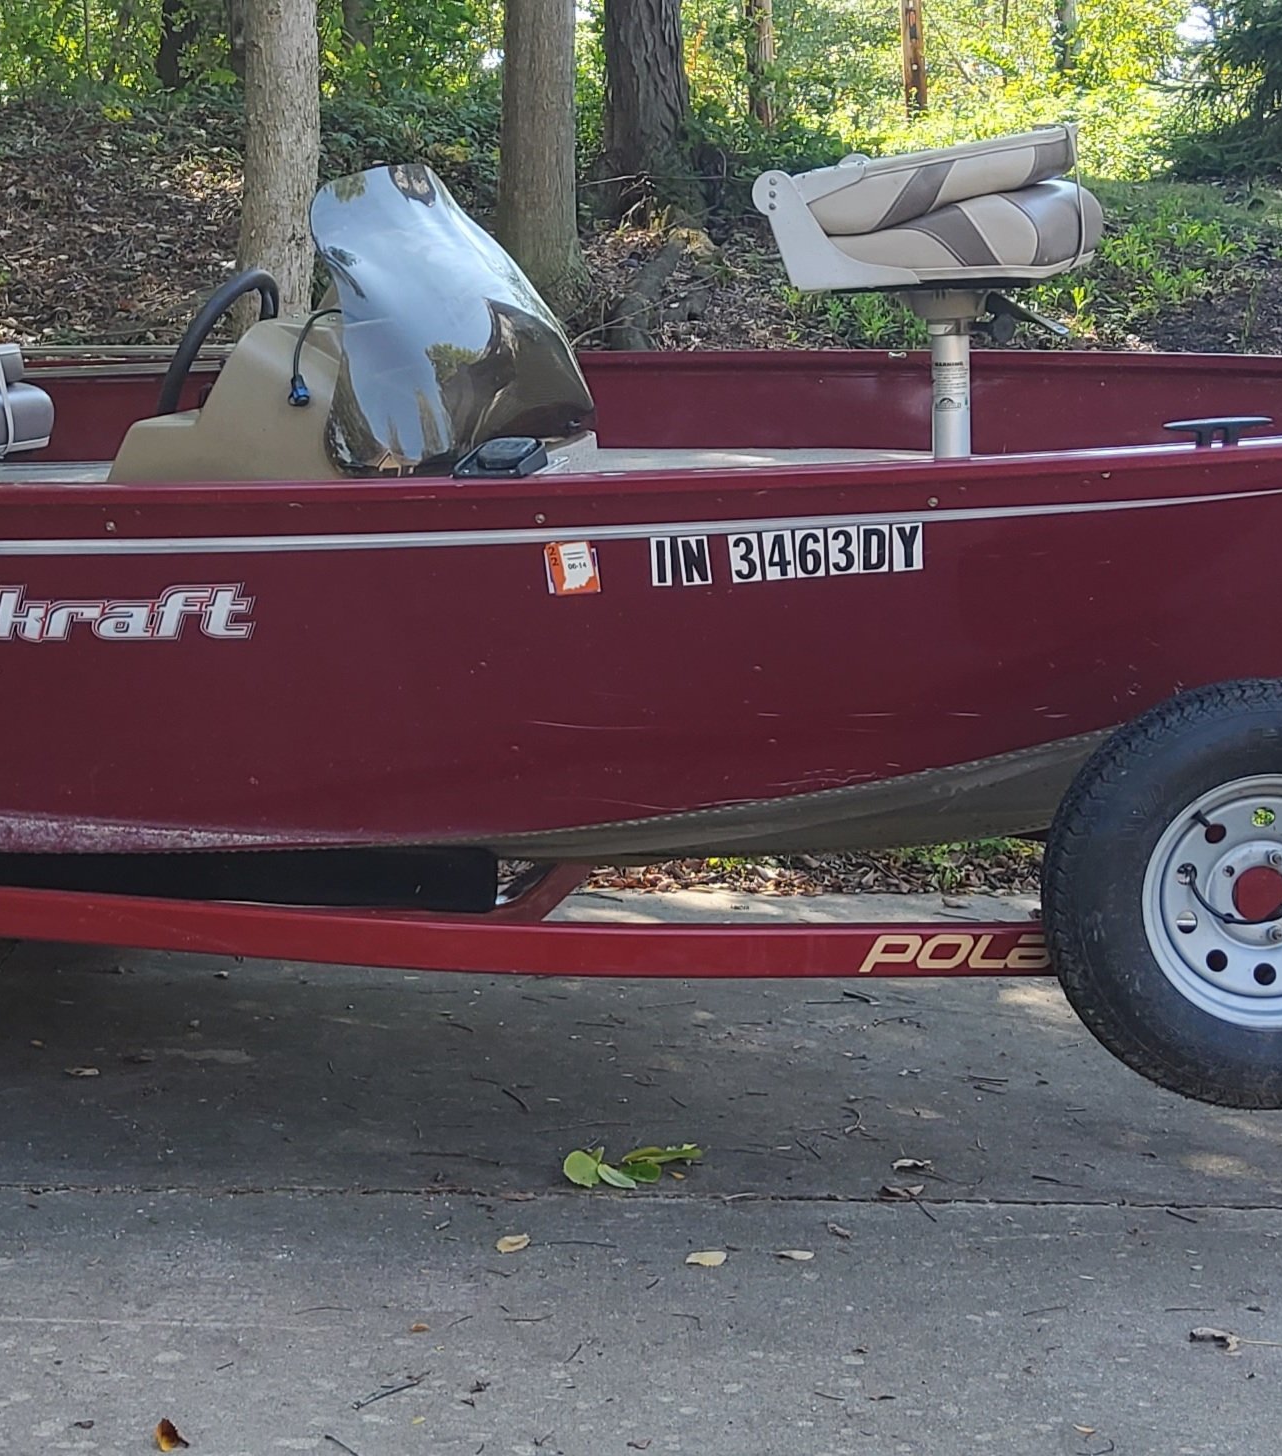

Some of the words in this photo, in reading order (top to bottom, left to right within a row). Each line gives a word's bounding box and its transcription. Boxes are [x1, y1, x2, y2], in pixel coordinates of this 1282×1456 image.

[655, 538, 710, 584] IN
[732, 525, 921, 580] 3463DY
[858, 934, 1052, 973] POLA
